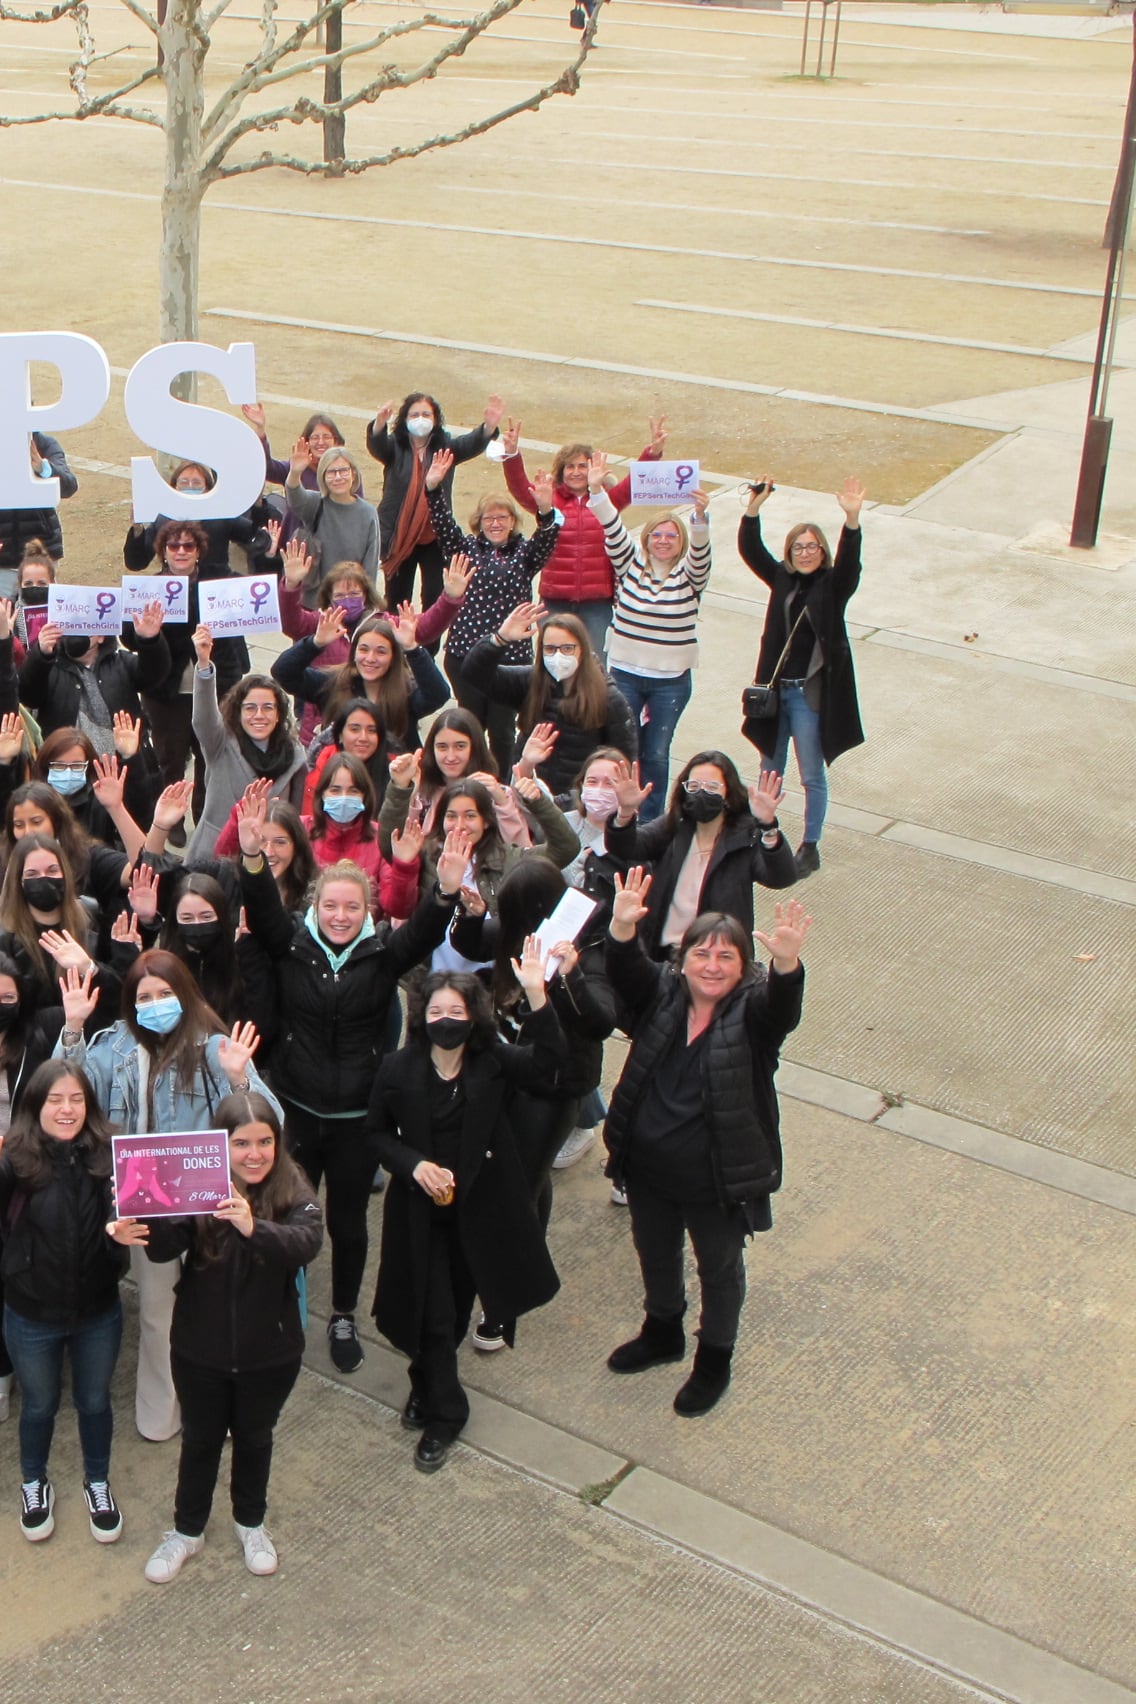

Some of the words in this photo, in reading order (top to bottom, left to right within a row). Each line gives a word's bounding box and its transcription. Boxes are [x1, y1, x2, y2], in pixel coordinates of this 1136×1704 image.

[134, 1146, 192, 1158] INTERNATIONAL
[194, 1146, 204, 1154] DE
[205, 1145, 220, 1154] LES
[184, 1156, 222, 1170] DONES
